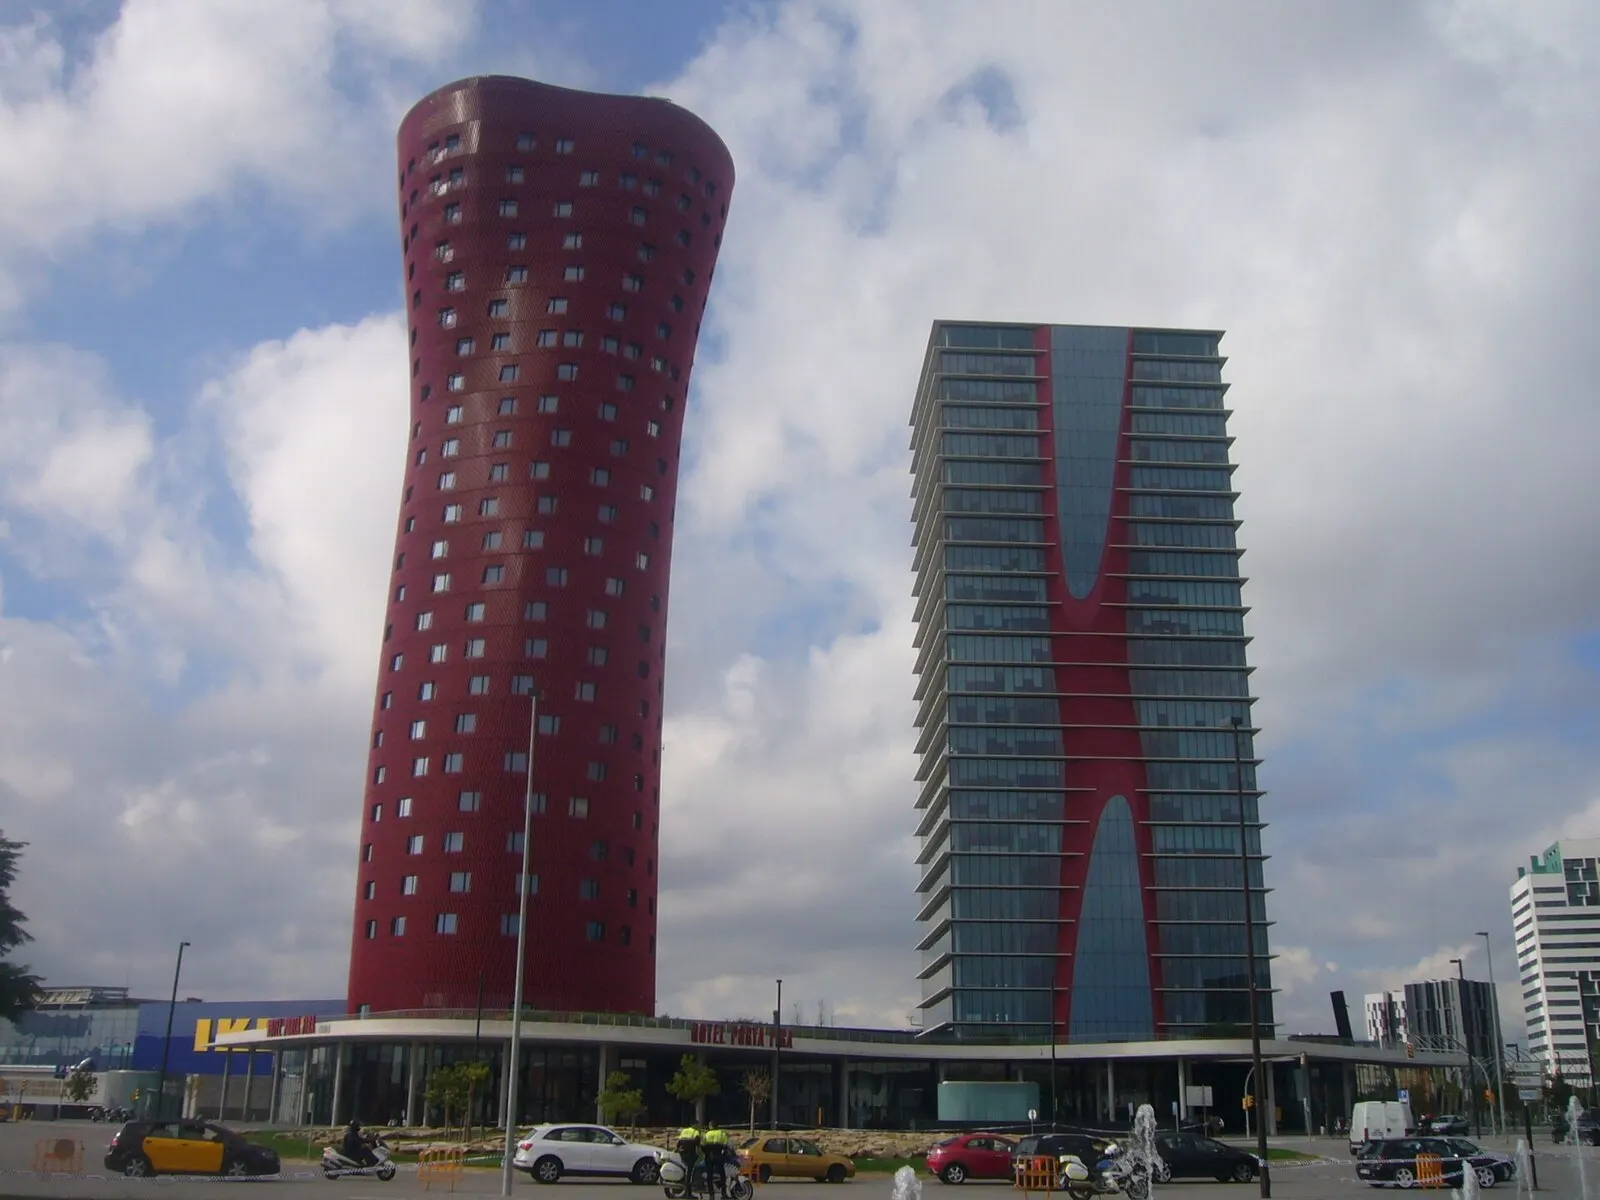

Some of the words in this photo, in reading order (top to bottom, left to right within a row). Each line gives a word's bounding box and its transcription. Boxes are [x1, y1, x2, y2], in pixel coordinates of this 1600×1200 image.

[691, 1022, 726, 1045] HOTEL
[731, 1025, 765, 1047] PORTA
[770, 1027, 793, 1049] FRA
